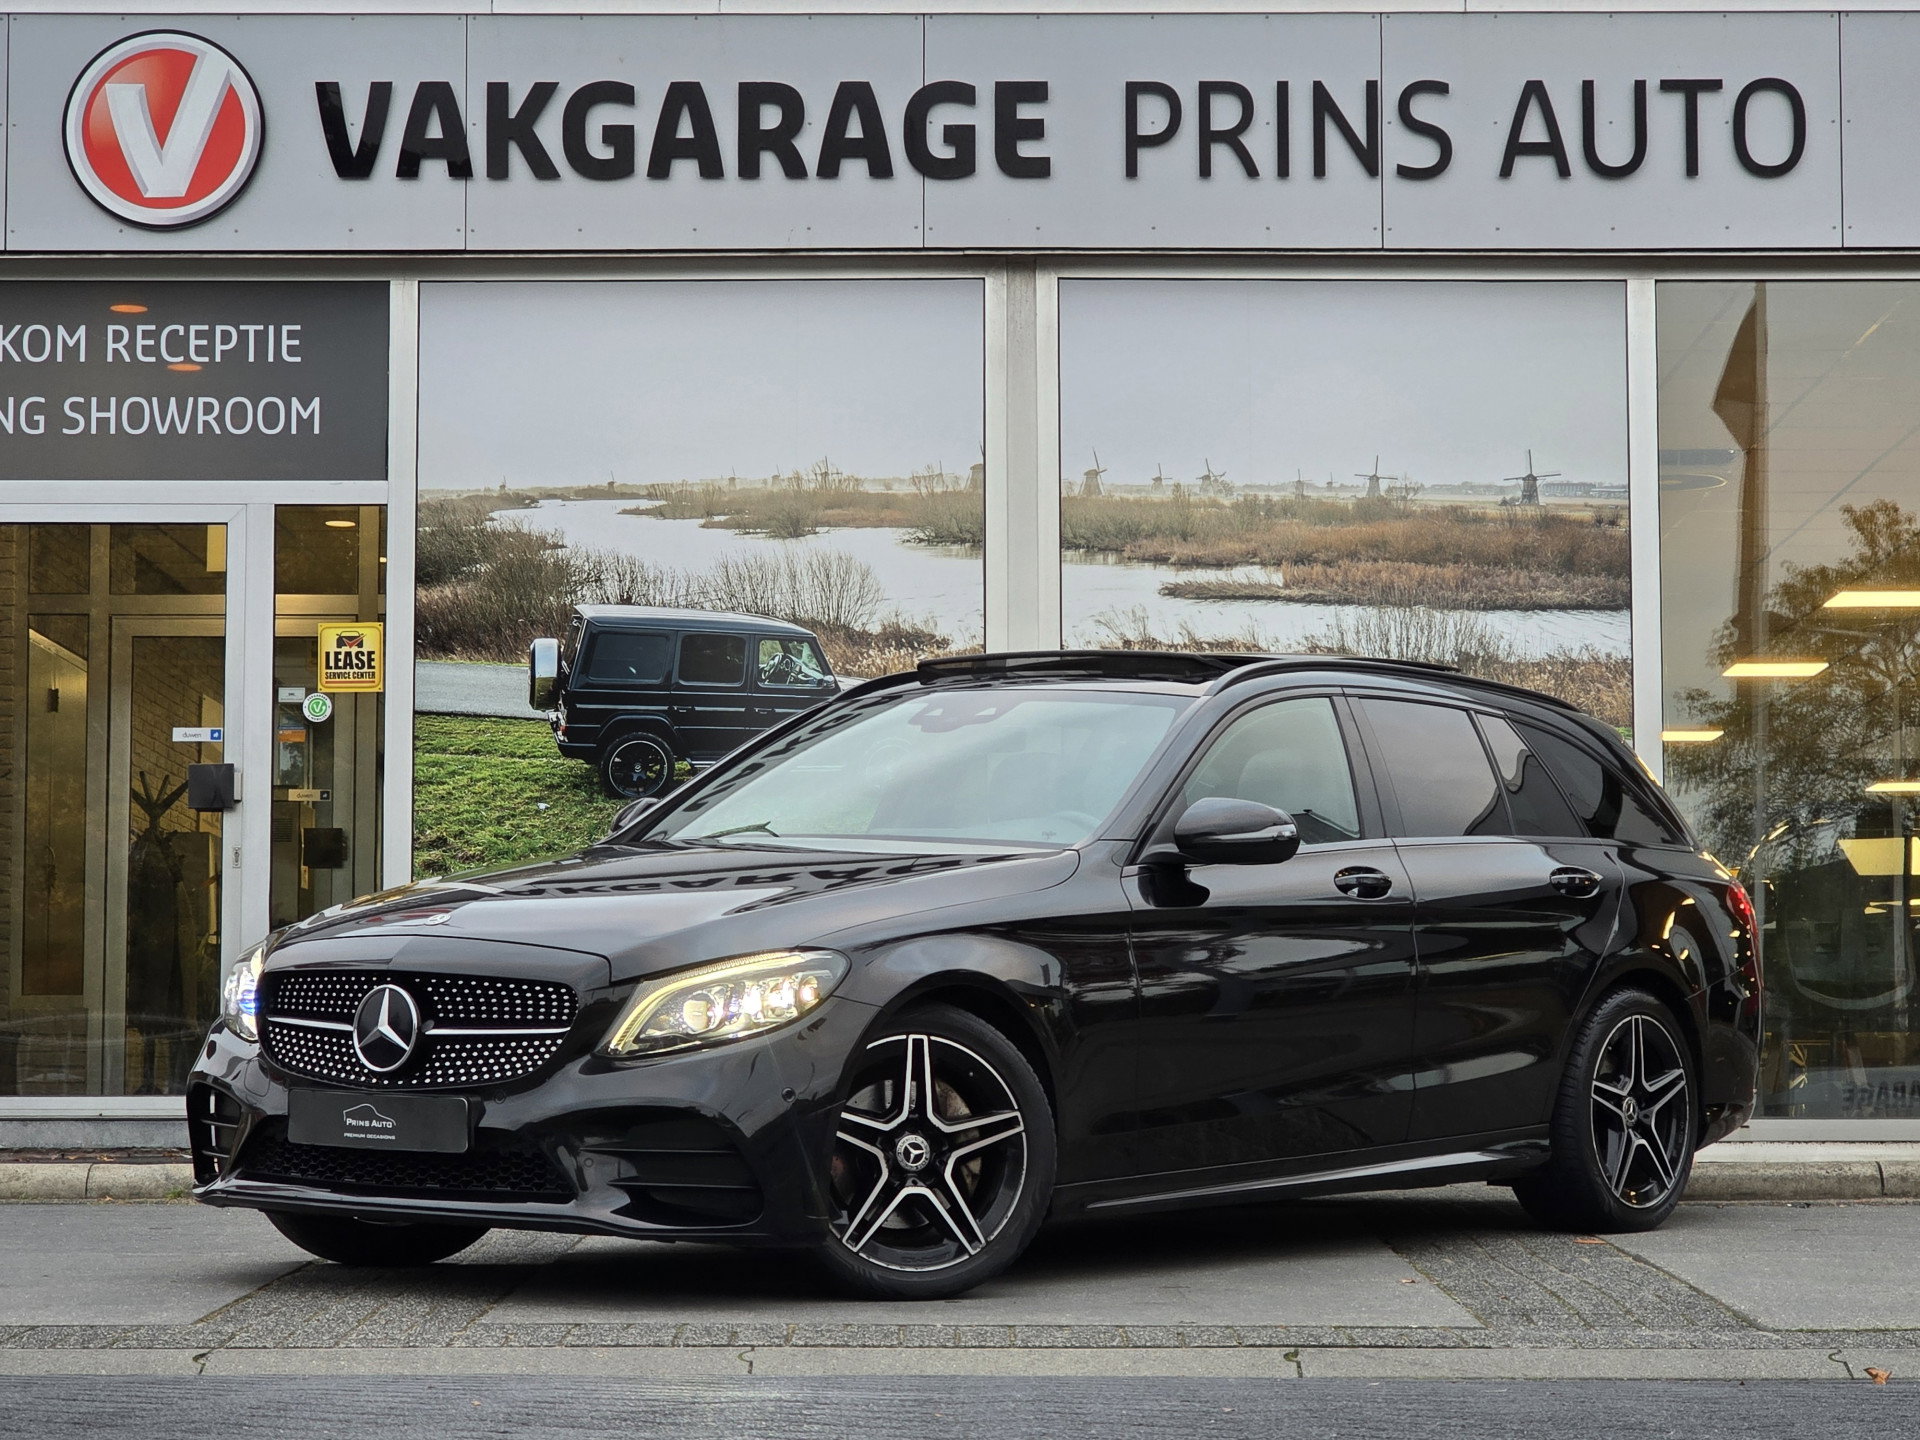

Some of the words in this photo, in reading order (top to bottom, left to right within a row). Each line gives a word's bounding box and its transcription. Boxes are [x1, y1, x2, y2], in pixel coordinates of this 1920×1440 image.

[315, 81, 1051, 180] VAKGARAGE
[1124, 80, 1453, 178] PRINS
[1499, 77, 1807, 178] AUTO
[106, 324, 302, 363] RECEPTIE
[62, 396, 320, 435] SHOWROOM
[325, 650, 376, 670] LEASE
[325, 671, 351, 680] SERVICE
[352, 671, 376, 680] CENTER
